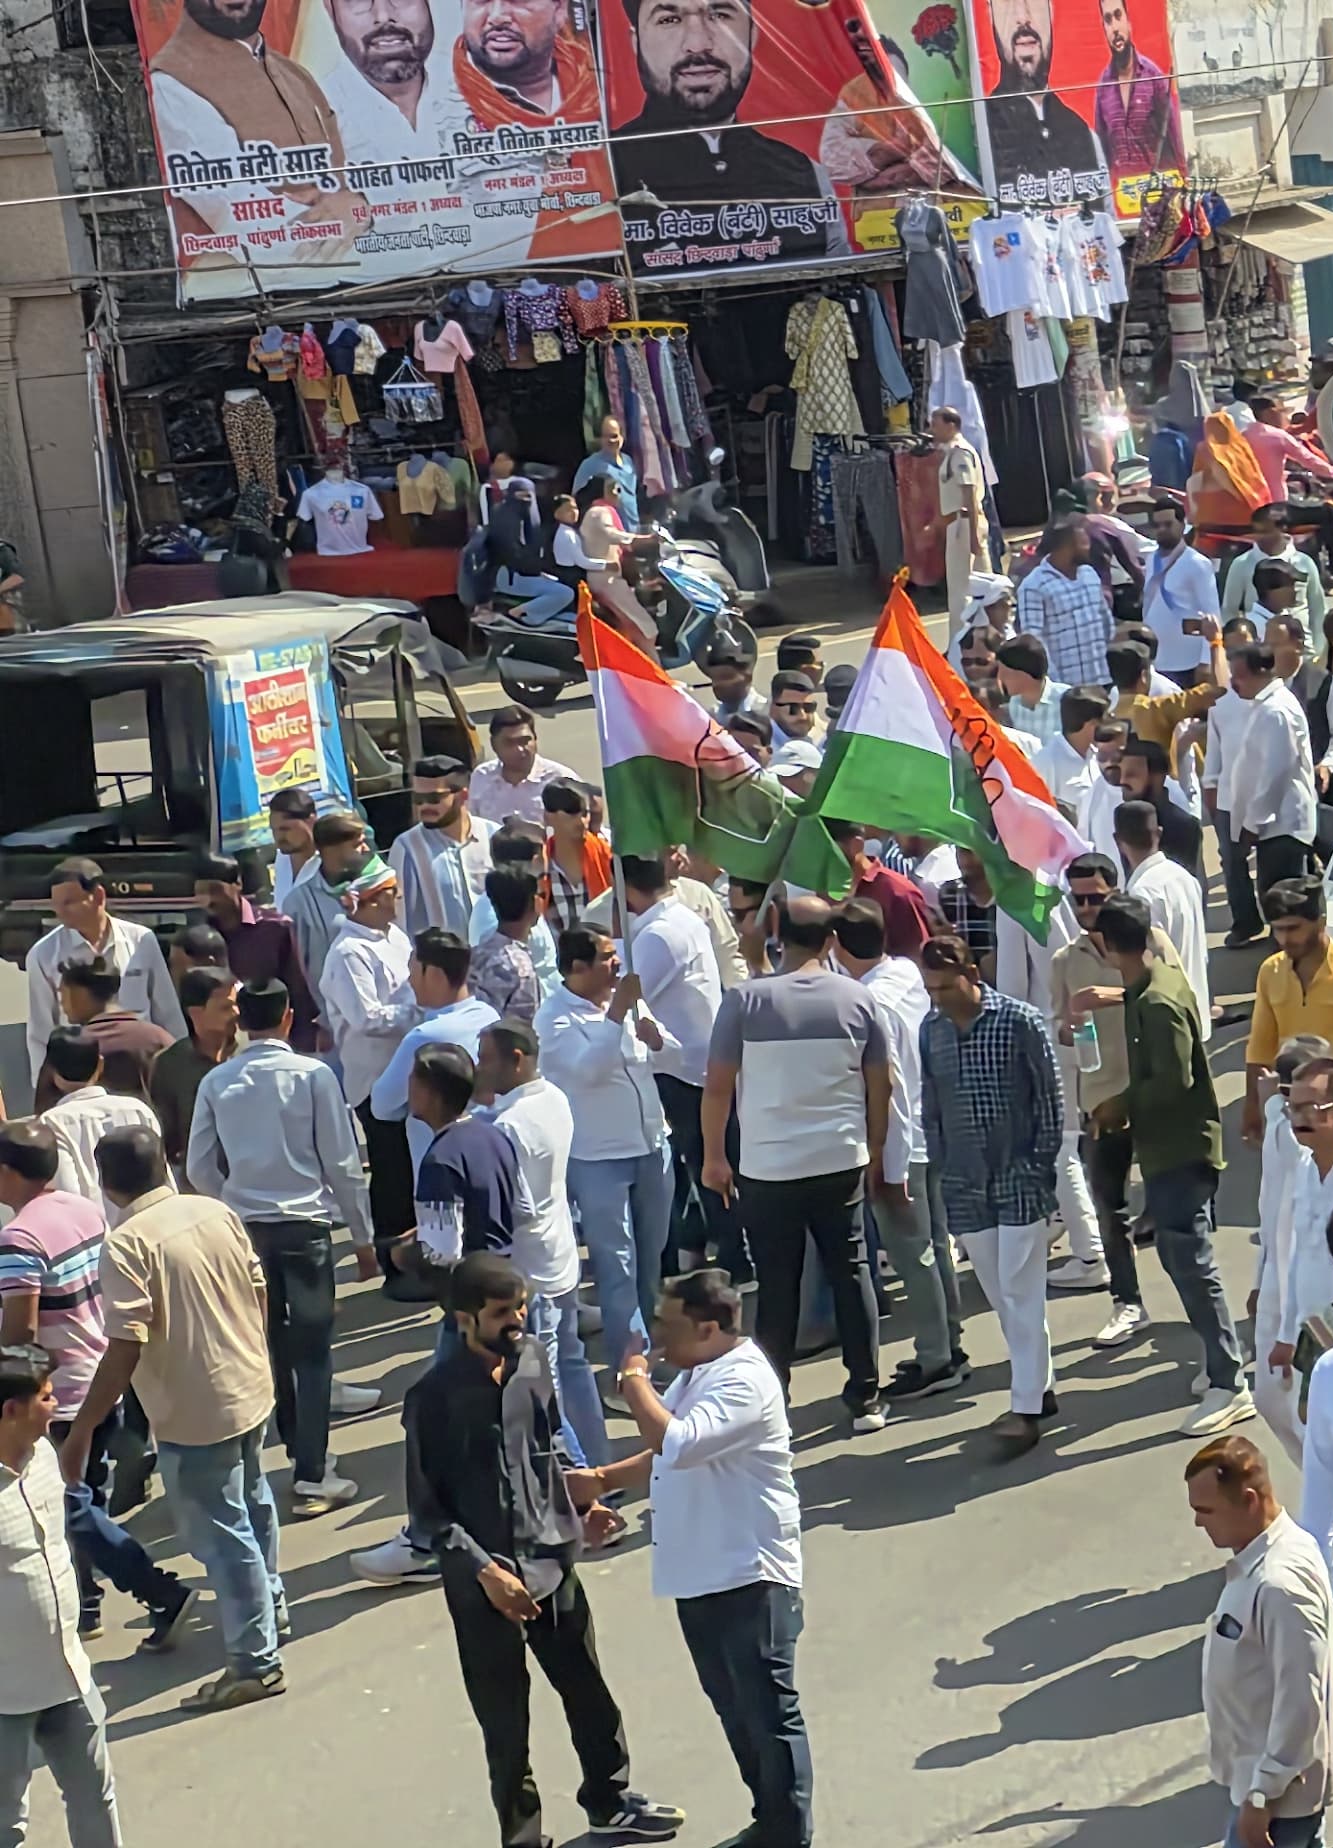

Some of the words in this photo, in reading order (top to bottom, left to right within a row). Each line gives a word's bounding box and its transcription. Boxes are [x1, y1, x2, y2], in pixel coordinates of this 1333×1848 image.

[498, 126, 546, 156] विवेक
[167, 150, 233, 193] विवेक
[236, 143, 280, 185] बंटी
[283, 147, 337, 190] साहू
[344, 160, 394, 190] रोहित
[396, 152, 456, 185] पोफली
[484, 178, 507, 192] नगर
[510, 173, 536, 188] मंडल
[230, 192, 286, 222] सांसद
[623, 219, 656, 242] मा.
[657, 208, 715, 240] विवेक
[717, 202, 768, 241] (बंटी)
[290, 222, 343, 242] लोकसभा
